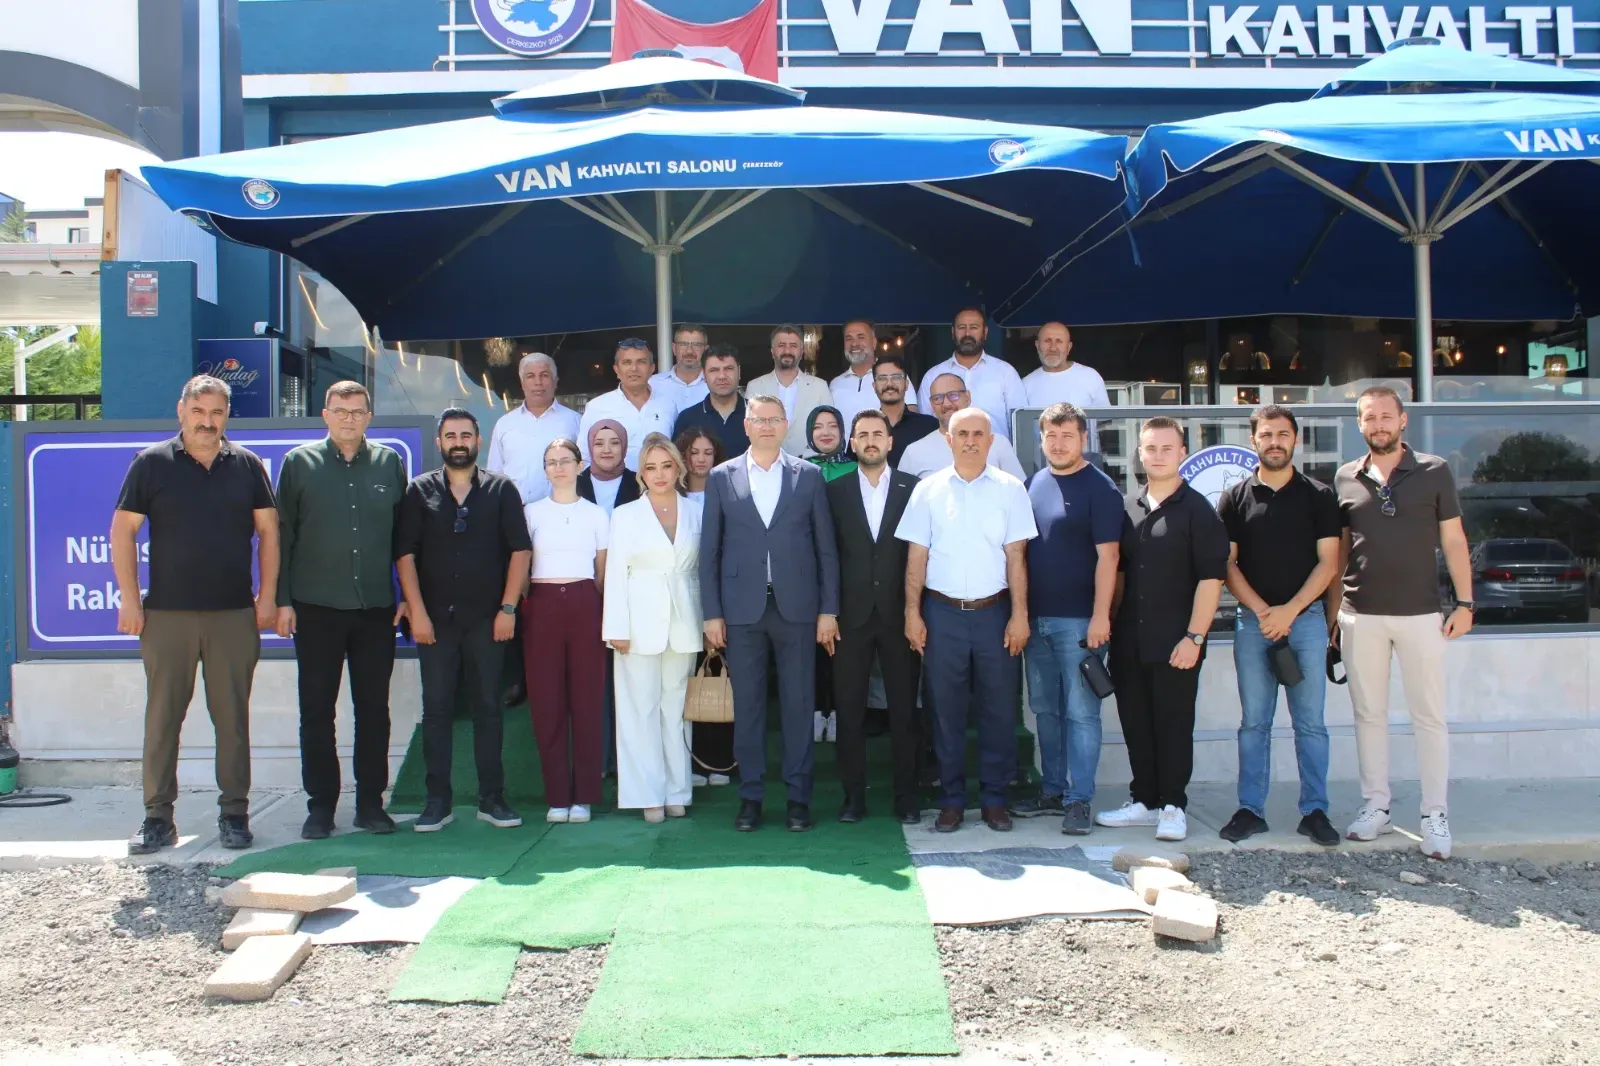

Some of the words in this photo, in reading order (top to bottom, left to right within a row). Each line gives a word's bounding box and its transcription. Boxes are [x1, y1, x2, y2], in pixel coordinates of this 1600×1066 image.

[822, 0, 1133, 55] VAN
[1209, 5, 1574, 57] KAHVALTI
[1503, 127, 1584, 153] VAN
[494, 161, 572, 193] VAN
[576, 160, 661, 180] KAHVALTI
[667, 158, 737, 174] SALONU
[1182, 451, 1243, 481] KAHVALTI
